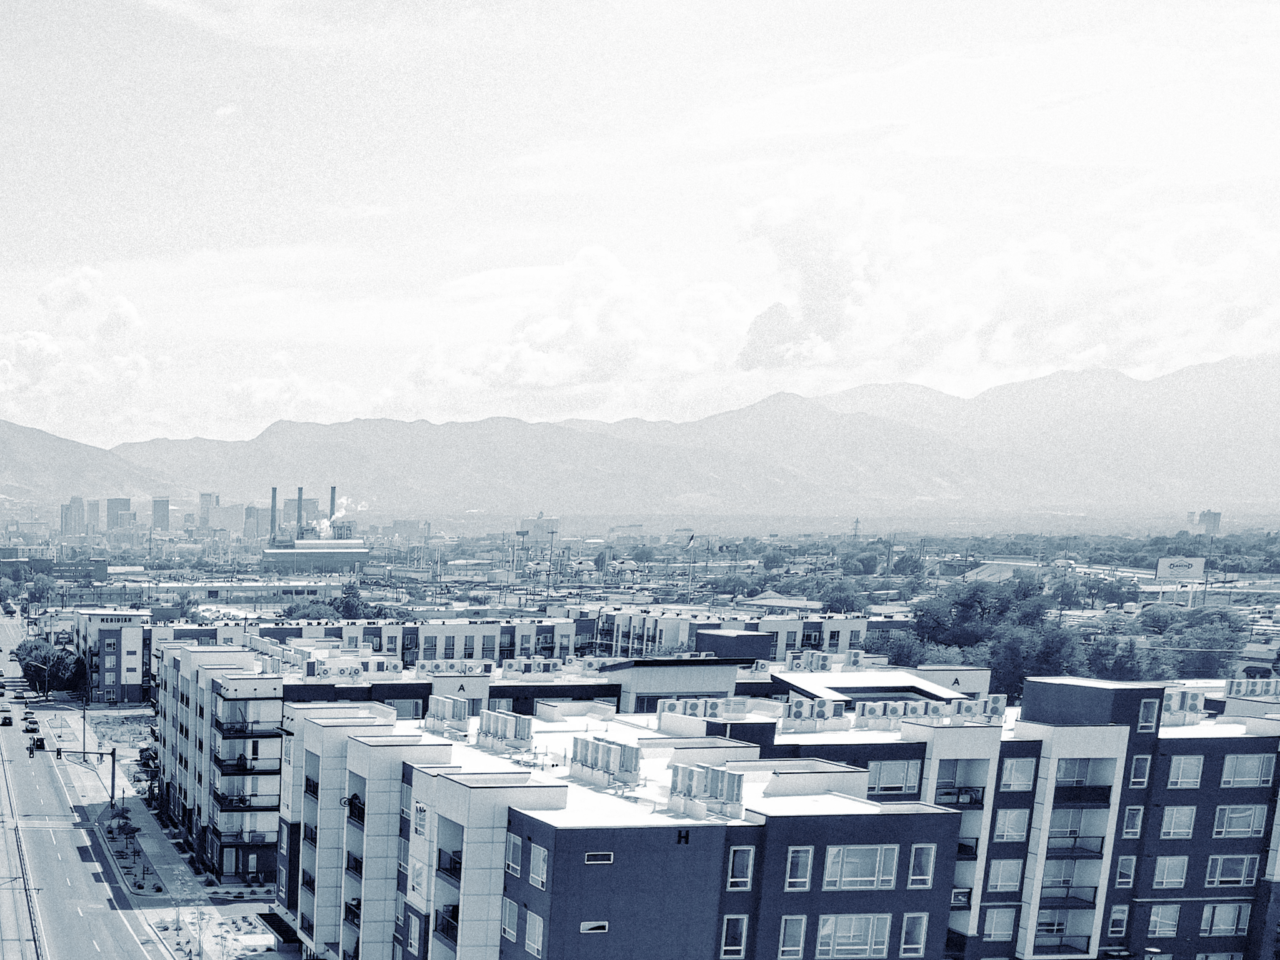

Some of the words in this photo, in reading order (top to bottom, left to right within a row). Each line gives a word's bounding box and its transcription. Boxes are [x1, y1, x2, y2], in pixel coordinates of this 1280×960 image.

[951, 677, 960, 686] A
[457, 683, 466, 693] A
[677, 829, 690, 845] H
